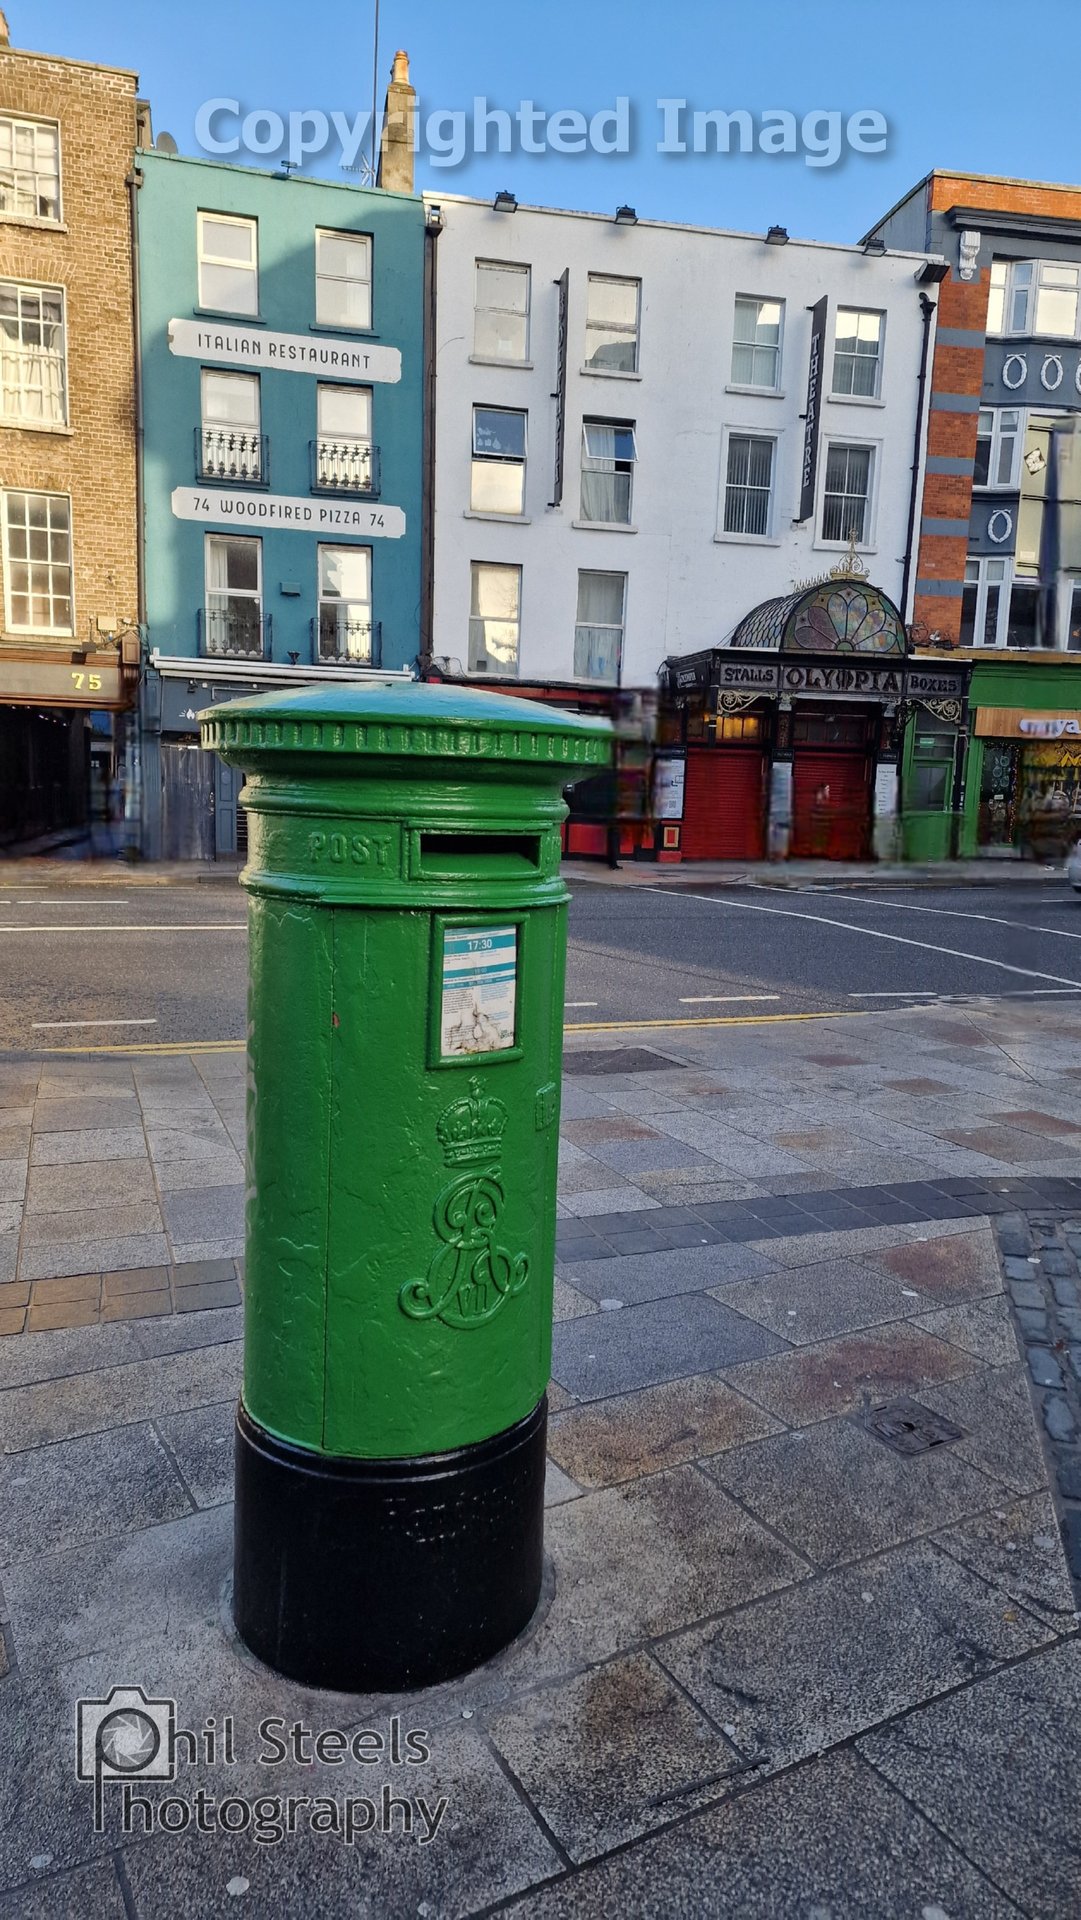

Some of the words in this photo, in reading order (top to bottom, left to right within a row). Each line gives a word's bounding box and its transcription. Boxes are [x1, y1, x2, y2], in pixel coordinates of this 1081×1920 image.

[198, 333, 261, 355] ITALIAN
[269, 343, 370, 369] RESTAURANT
[802, 332, 820, 489] THEATRE
[193, 497, 209, 512] 74
[220, 499, 312, 521] WOODFIRED
[320, 508, 360, 525] PIZZA
[370, 513, 385, 528] 74
[71, 672, 102, 690] 75
[724, 667, 774, 683] STALLS
[910, 675, 958, 692] BOXES
[310, 831, 392, 865] POST
[467, 938, 493, 951] 17:30
